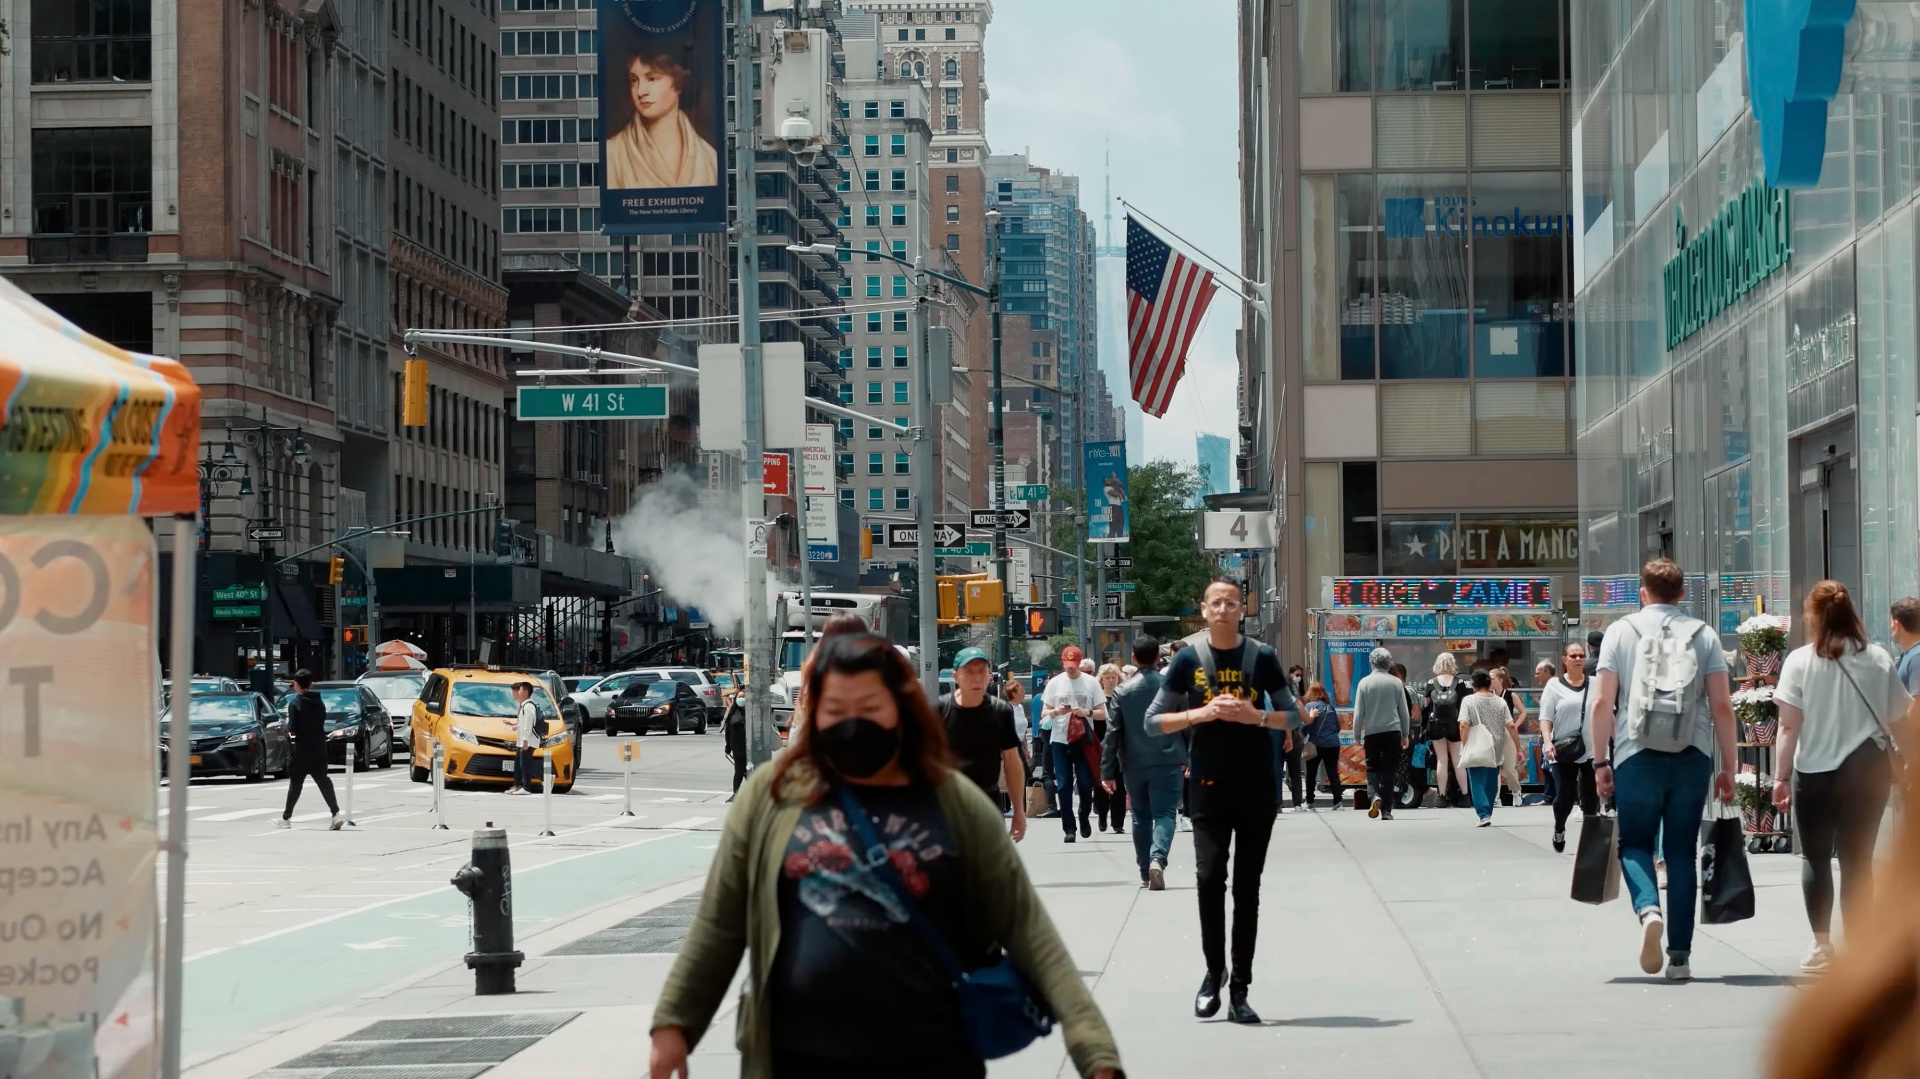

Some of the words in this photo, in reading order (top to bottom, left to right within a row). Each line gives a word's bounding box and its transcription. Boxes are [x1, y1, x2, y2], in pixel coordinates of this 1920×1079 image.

[622, 2, 632, 16] THE
[631, 16, 666, 33] POLONSKY
[622, 198, 645, 207] FREE
[648, 196, 704, 206] EXHIBITION
[1434, 196, 1477, 206] BOOKS
[561, 393, 575, 412] W
[582, 393, 599, 411] 41
[606, 393, 625, 412] St
[1017, 488, 1024, 498] W
[1028, 488, 1037, 498] 41
[1230, 515, 1248, 542] 4
[899, 531, 919, 541] ONE
[934, 531, 954, 541] WAY
[1497, 529, 1510, 560] A
[235, 590, 248, 598] 40th
[250, 590, 258, 598] St
[1036, 678, 1043, 687] P
